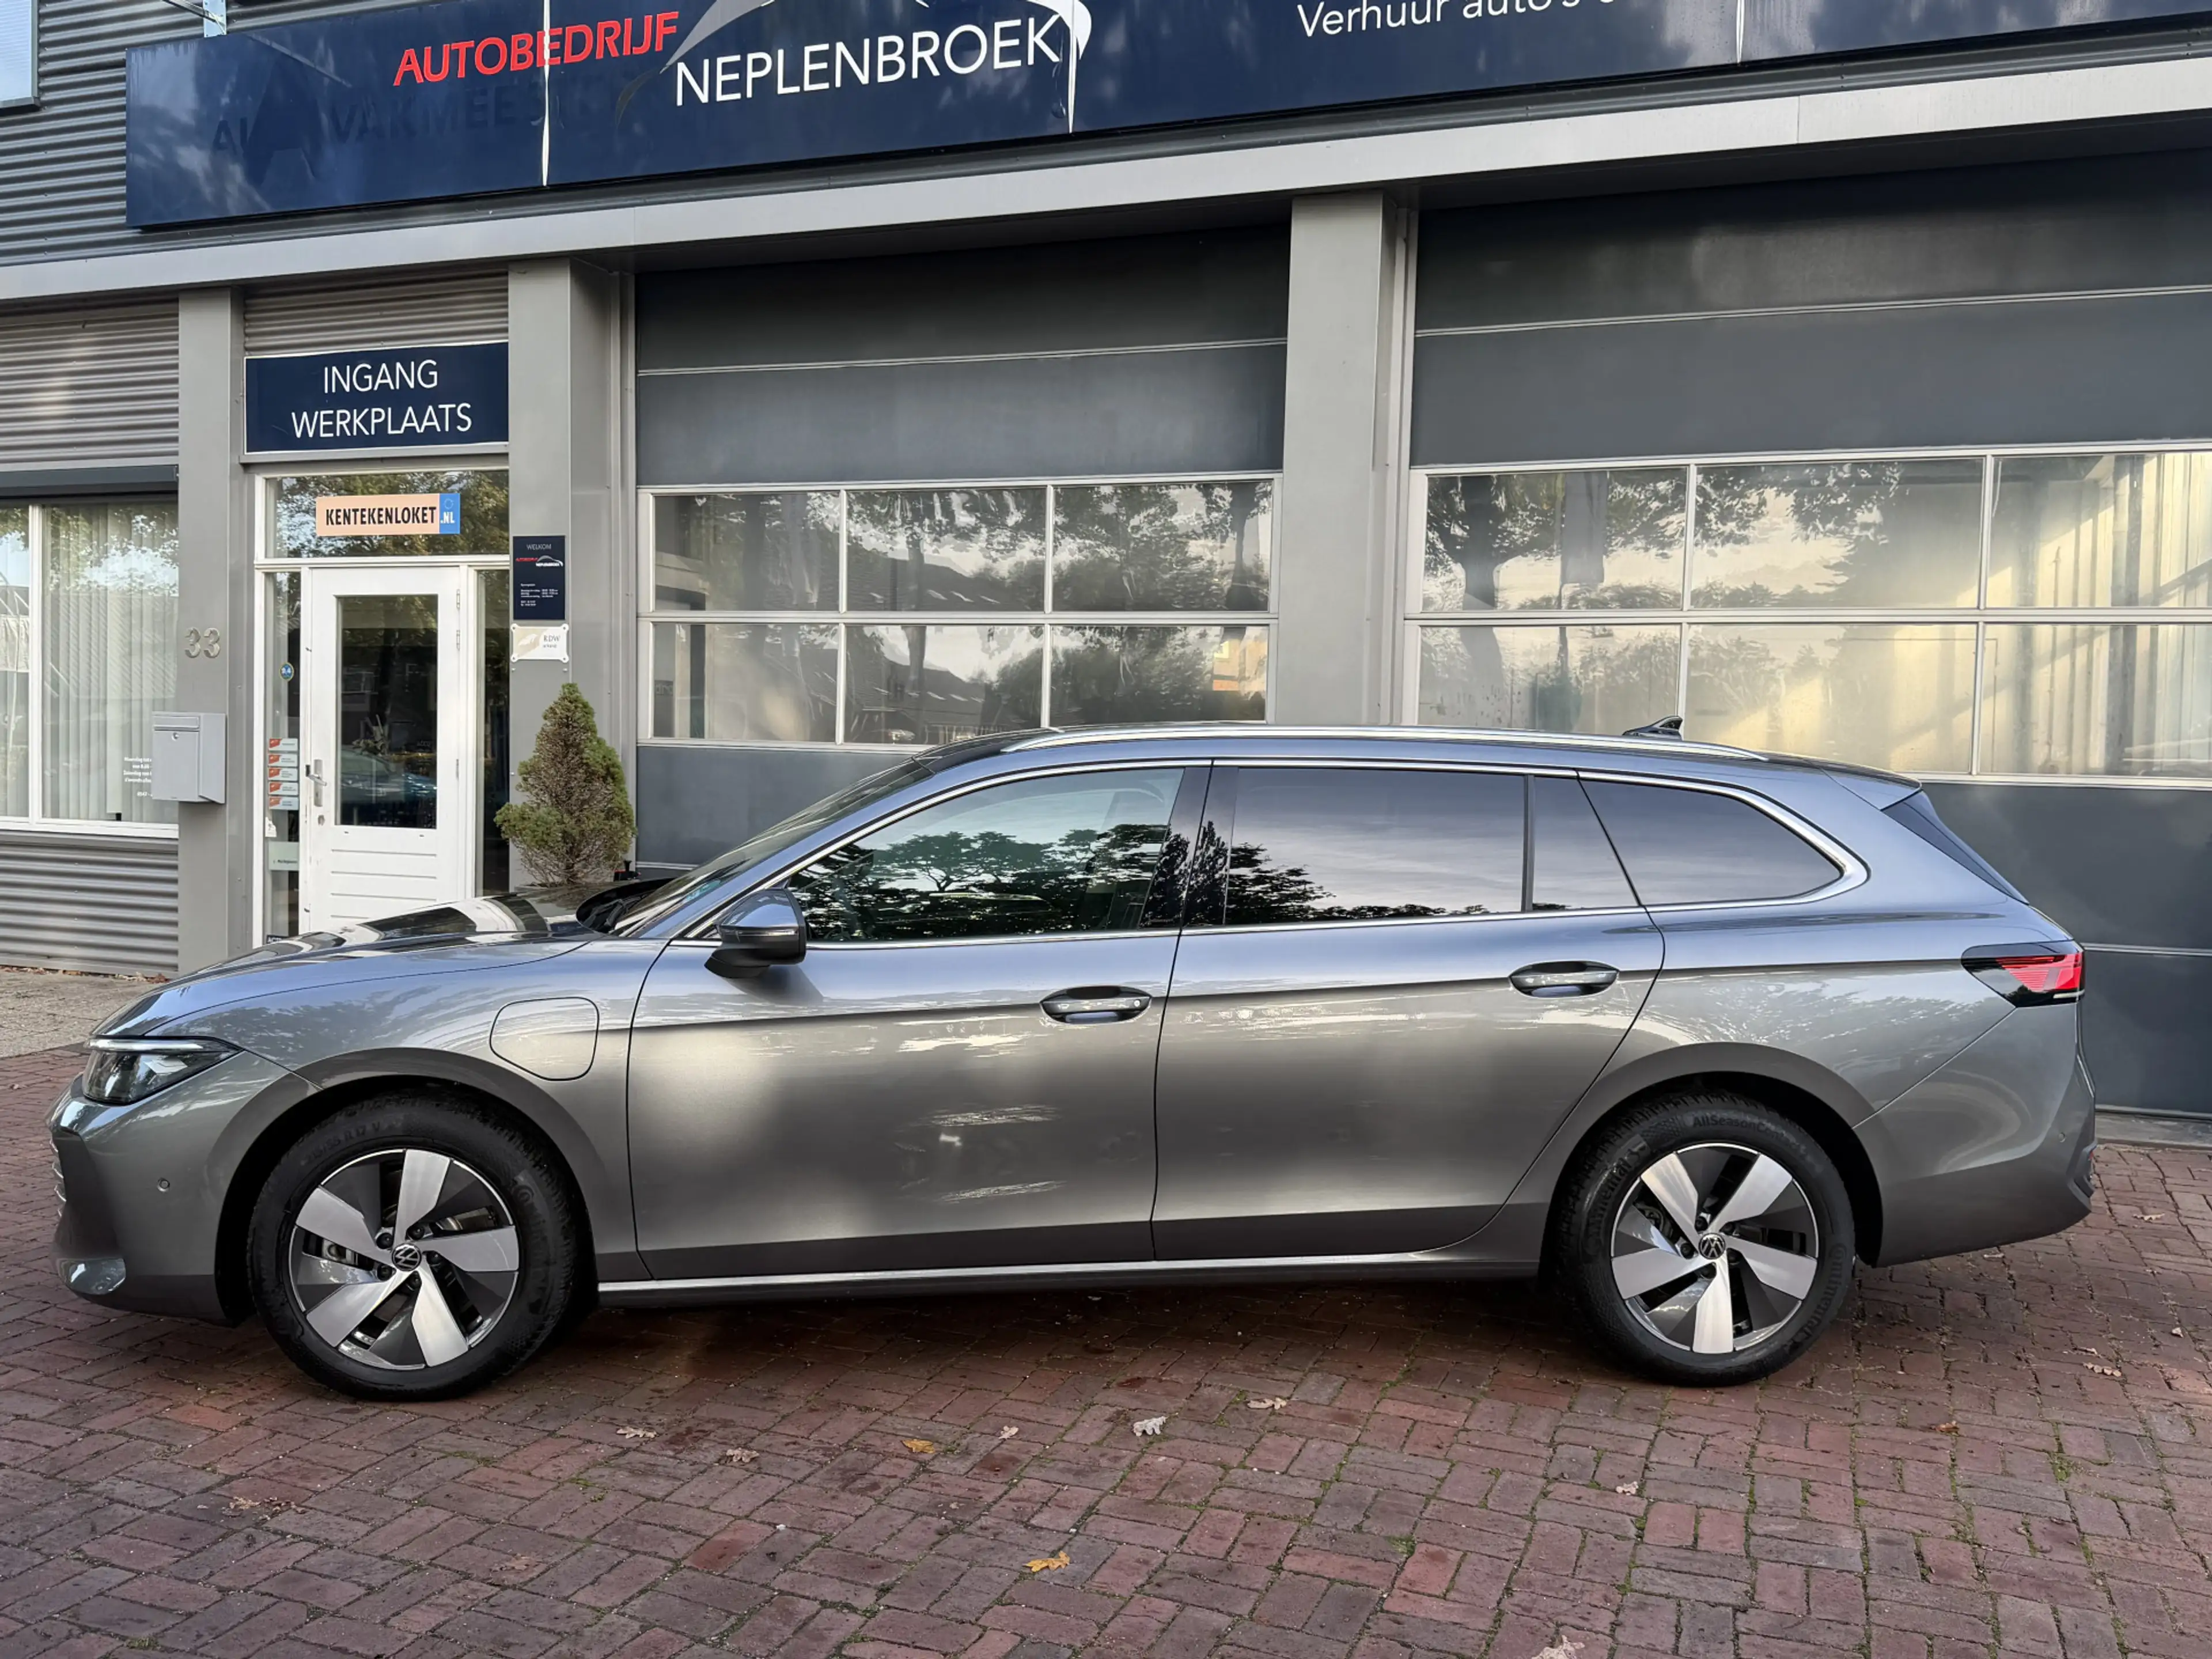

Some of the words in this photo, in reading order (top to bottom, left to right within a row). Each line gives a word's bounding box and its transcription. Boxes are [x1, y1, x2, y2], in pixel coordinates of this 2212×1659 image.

[1297, 0, 1450, 37] Verhuur
[393, 11, 679, 86] AUTOBEDRIJF
[676, 14, 1062, 107] NEPLENBROEK
[324, 359, 438, 394] INGANG
[291, 403, 472, 438] WERKPLAATS
[325, 506, 437, 527] KENTEKENLOKET
[184, 627, 221, 659] 33
